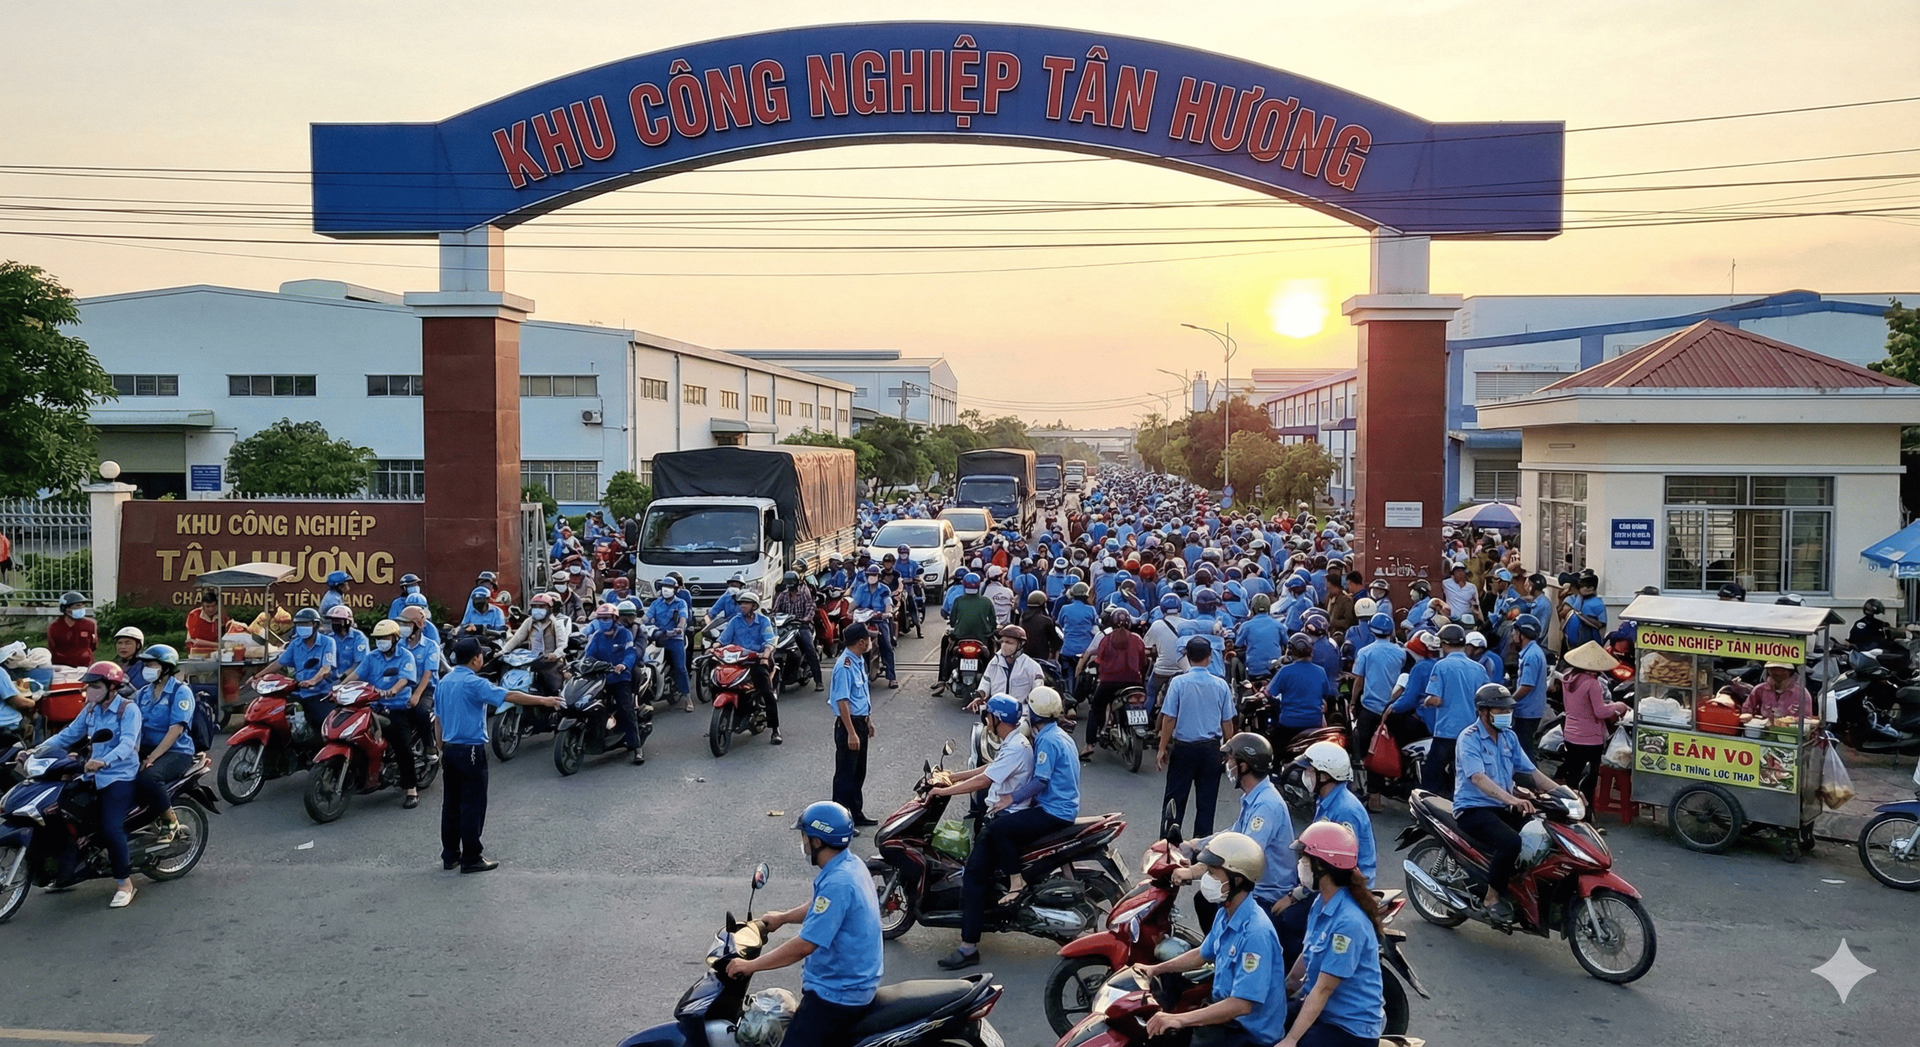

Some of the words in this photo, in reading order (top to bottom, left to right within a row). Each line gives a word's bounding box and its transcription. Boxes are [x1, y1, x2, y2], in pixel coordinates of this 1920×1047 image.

[493, 96, 616, 189] KHU
[628, 59, 791, 147] CÔNG
[806, 34, 1021, 128] NGHIỆP
[1043, 45, 1158, 133] TÂN
[1169, 76, 1372, 191] HƯƠNG
[176, 514, 222, 535] KHU
[228, 509, 288, 536] CÔNG
[295, 509, 377, 541] NGHIỆP
[1678, 635, 1724, 654] NGHIỆP
[1726, 638, 1751, 653] TÂN
[1754, 641, 1800, 659] HƯƠNG
[1723, 748, 1753, 767] VO
